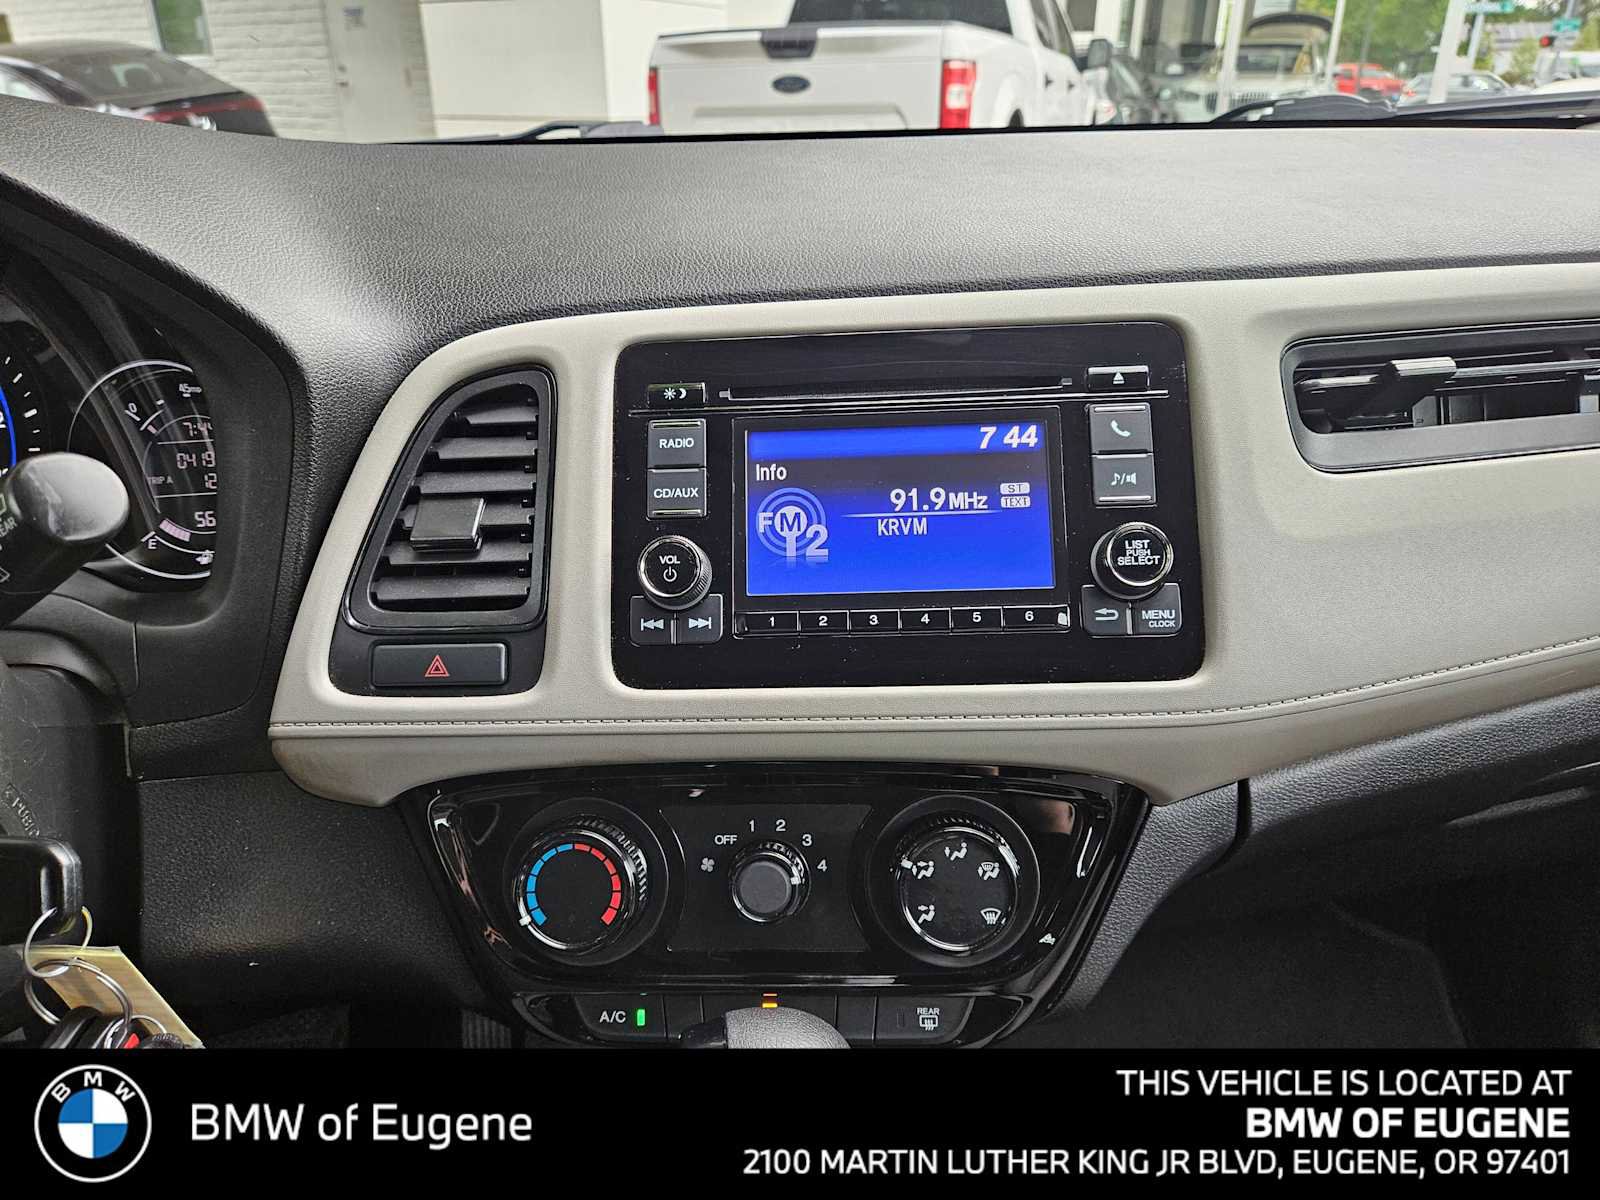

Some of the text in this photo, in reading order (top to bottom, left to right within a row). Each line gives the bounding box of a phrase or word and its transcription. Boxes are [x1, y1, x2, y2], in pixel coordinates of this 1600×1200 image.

[979, 424, 1039, 449] 7 44
[658, 437, 694, 449] RADIO
[755, 463, 787, 481] Info
[653, 487, 699, 500] CD/AUX
[1007, 484, 1023, 494] ST
[889, 487, 989, 512] 91.9 MHz
[1005, 497, 1028, 507] TEXT
[877, 517, 928, 537] KRVM
[148, 539, 157, 549] E
[1125, 540, 1150, 550] LIST
[659, 554, 680, 566] VOL
[1117, 556, 1160, 566] SELECT
[869, 614, 879, 625] 3
[921, 613, 930, 624] 4
[972, 612, 981, 623] 5
[1024, 611, 1034, 622] 6
[1142, 609, 1176, 620] MENU
[769, 616, 775, 626] 1
[819, 615, 828, 626] 2
[1148, 620, 1176, 628] CLOCK
[749, 819, 756, 832] 1
[775, 819, 786, 832] 2
[714, 834, 738, 845] OFF
[801, 834, 812, 847] 3
[817, 859, 828, 872] 4
[916, 1006, 940, 1016] REAR
[599, 1010, 627, 1024] A/C
